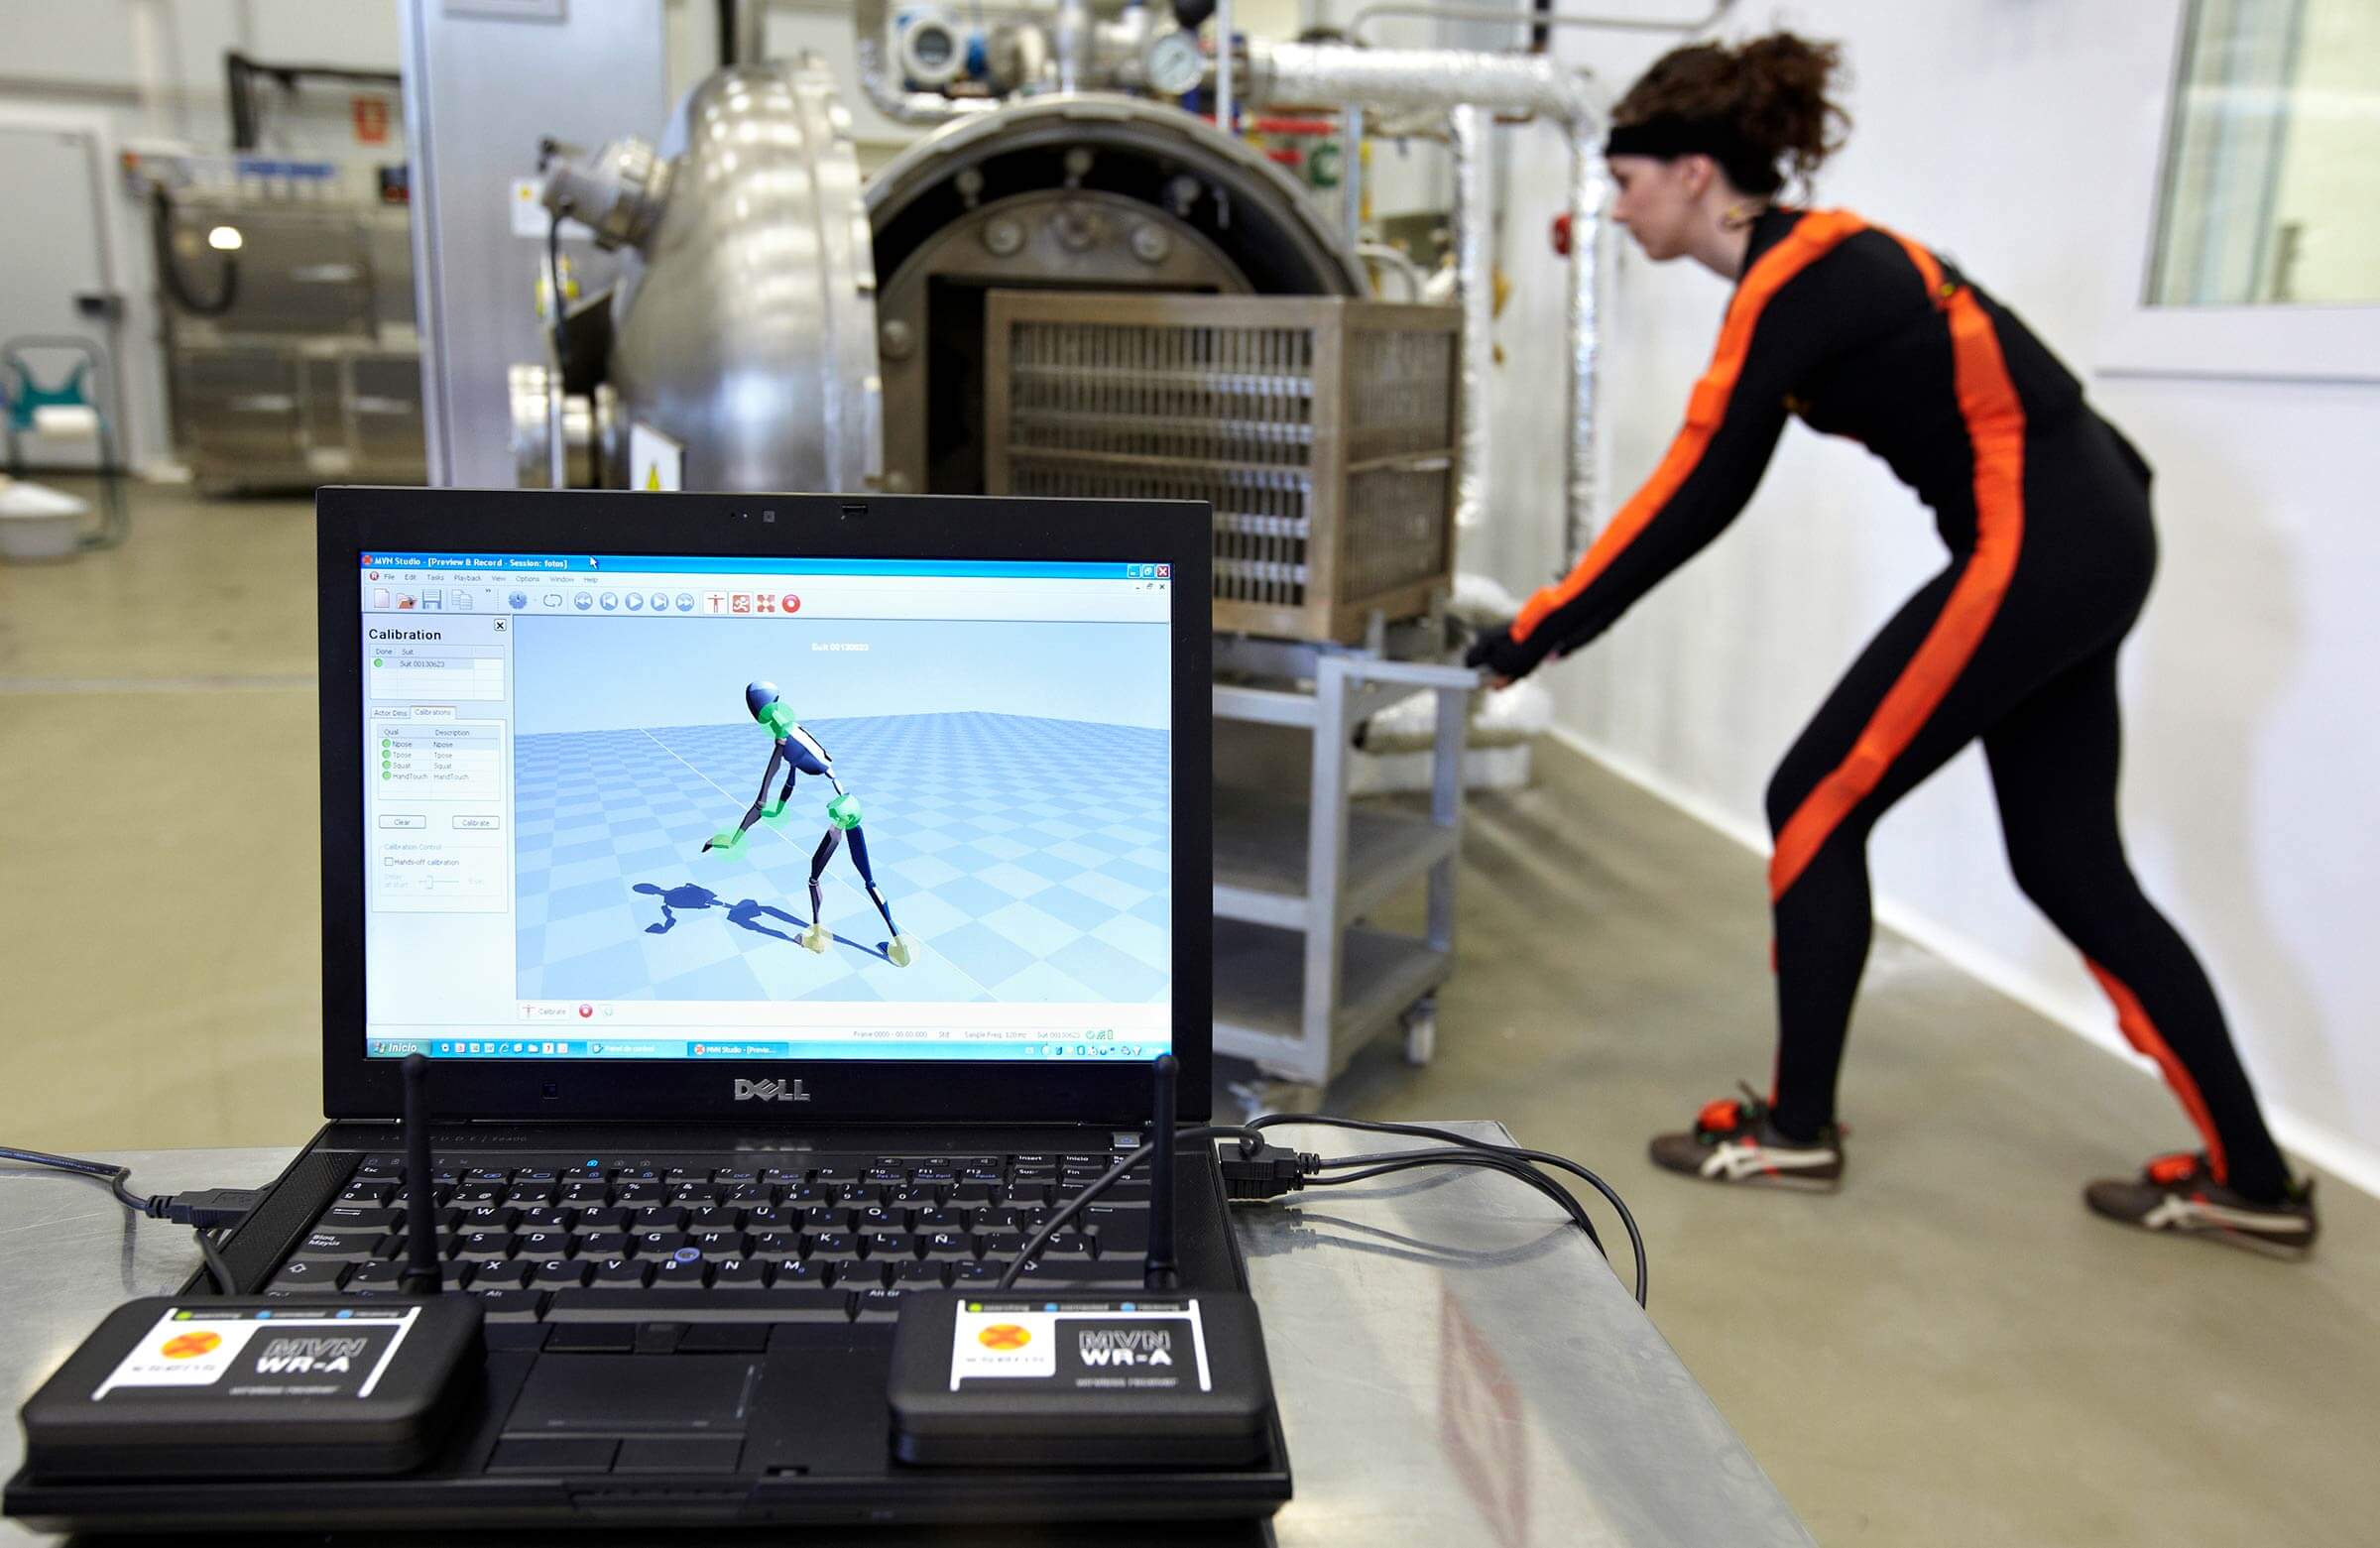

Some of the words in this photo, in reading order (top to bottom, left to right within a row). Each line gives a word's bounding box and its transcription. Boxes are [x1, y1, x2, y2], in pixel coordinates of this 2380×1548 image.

[474, 558, 503, 567] Record
[369, 629, 441, 641] Calibration
[387, 1042, 418, 1054] Inicio
[734, 1078, 811, 1102] DELL
[701, 1207, 714, 1216] Y
[756, 1207, 769, 1216] U
[811, 1207, 818, 1216] I
[922, 1207, 934, 1216] P
[705, 1233, 719, 1242] H
[763, 1233, 774, 1242] J
[820, 1233, 832, 1242] K
[934, 1233, 949, 1244] Ñ
[545, 1261, 560, 1270] C
[608, 1260, 622, 1269] V
[724, 1260, 740, 1270] N
[783, 1260, 800, 1270] M
[1078, 1330, 1172, 1351] MVN
[261, 1337, 369, 1358] MVN
[1080, 1349, 1173, 1367] WR-A
[255, 1356, 350, 1373] WR-A
